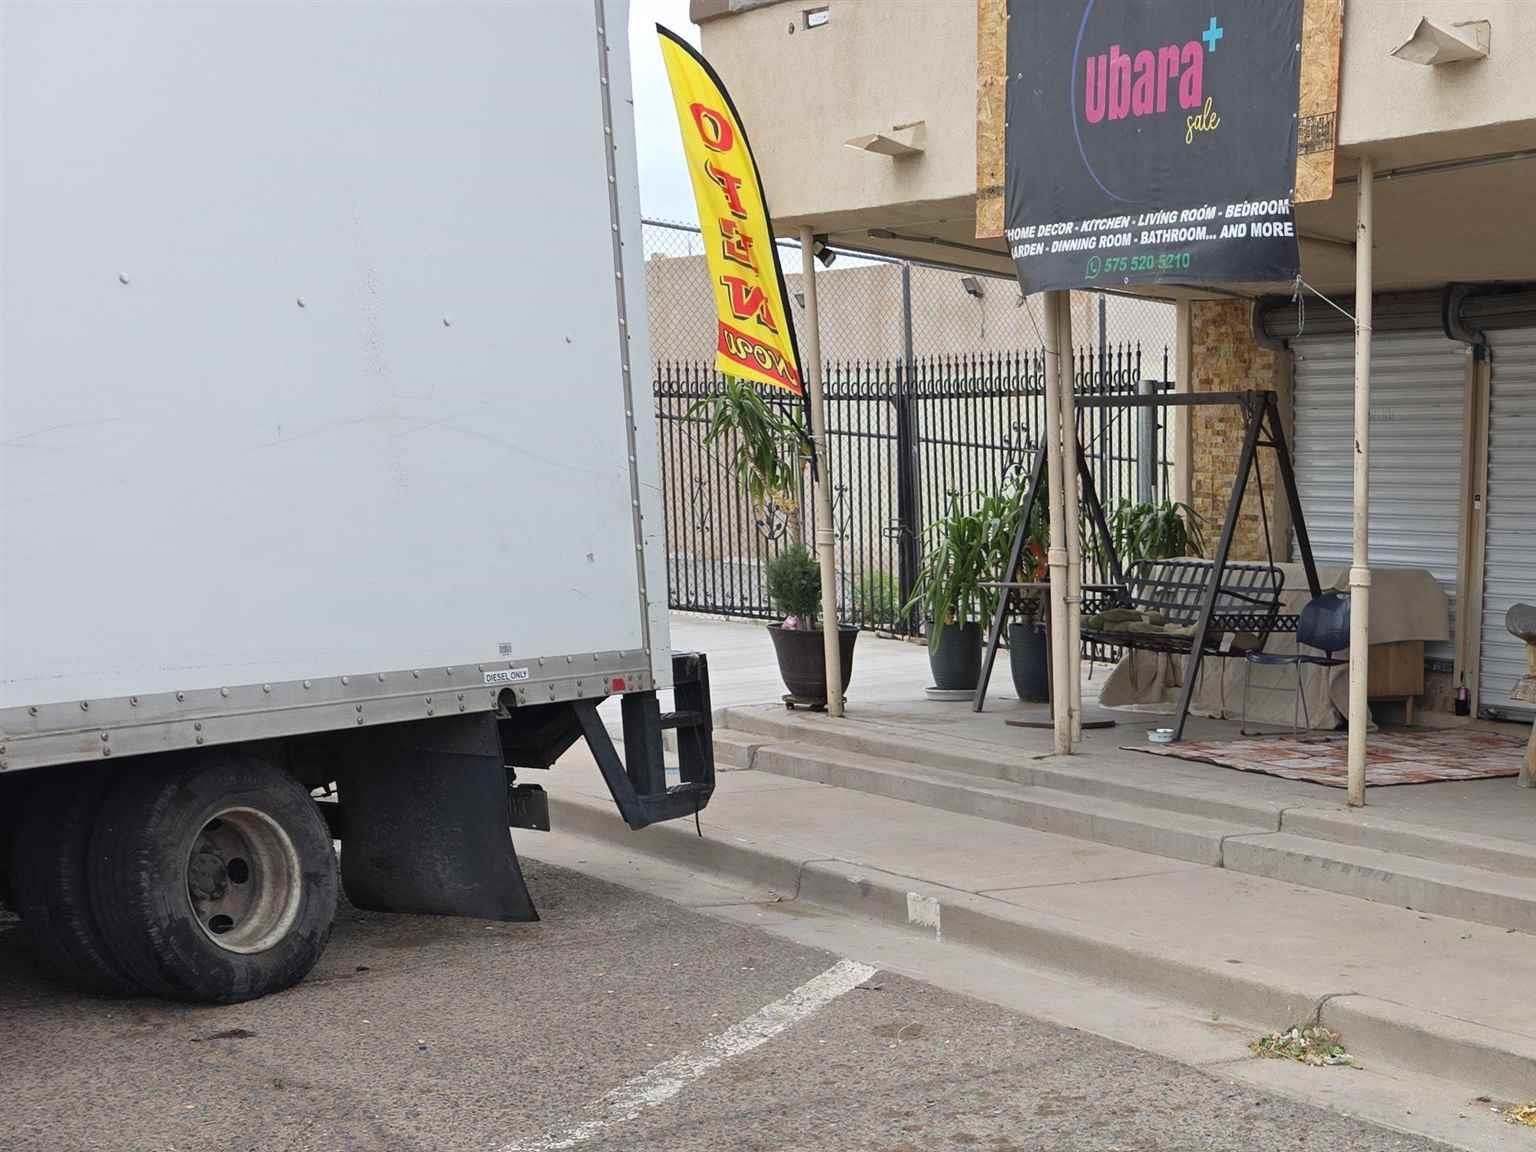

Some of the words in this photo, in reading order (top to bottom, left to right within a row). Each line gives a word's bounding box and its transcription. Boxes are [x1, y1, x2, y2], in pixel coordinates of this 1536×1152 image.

[1185, 96, 1221, 144] sale
[1007, 226, 1036, 242] HOME
[1037, 222, 1074, 237] DECOR
[1080, 215, 1131, 233] KITCHEN
[1137, 209, 1178, 226] LIVING
[1180, 205, 1217, 223] ROOM
[1224, 199, 1290, 218] BEDROOM
[1051, 237, 1097, 253] DINNING
[1099, 232, 1132, 249] ROOM
[1140, 226, 1217, 245] BATHROOM...
[1219, 223, 1248, 239] AND
[1250, 222, 1294, 237] MORE
[1104, 257, 1128, 272] 575
[1130, 255, 1154, 272] 520
[486, 672, 510, 682] DIESEL
[510, 670, 528, 680] ONLY
